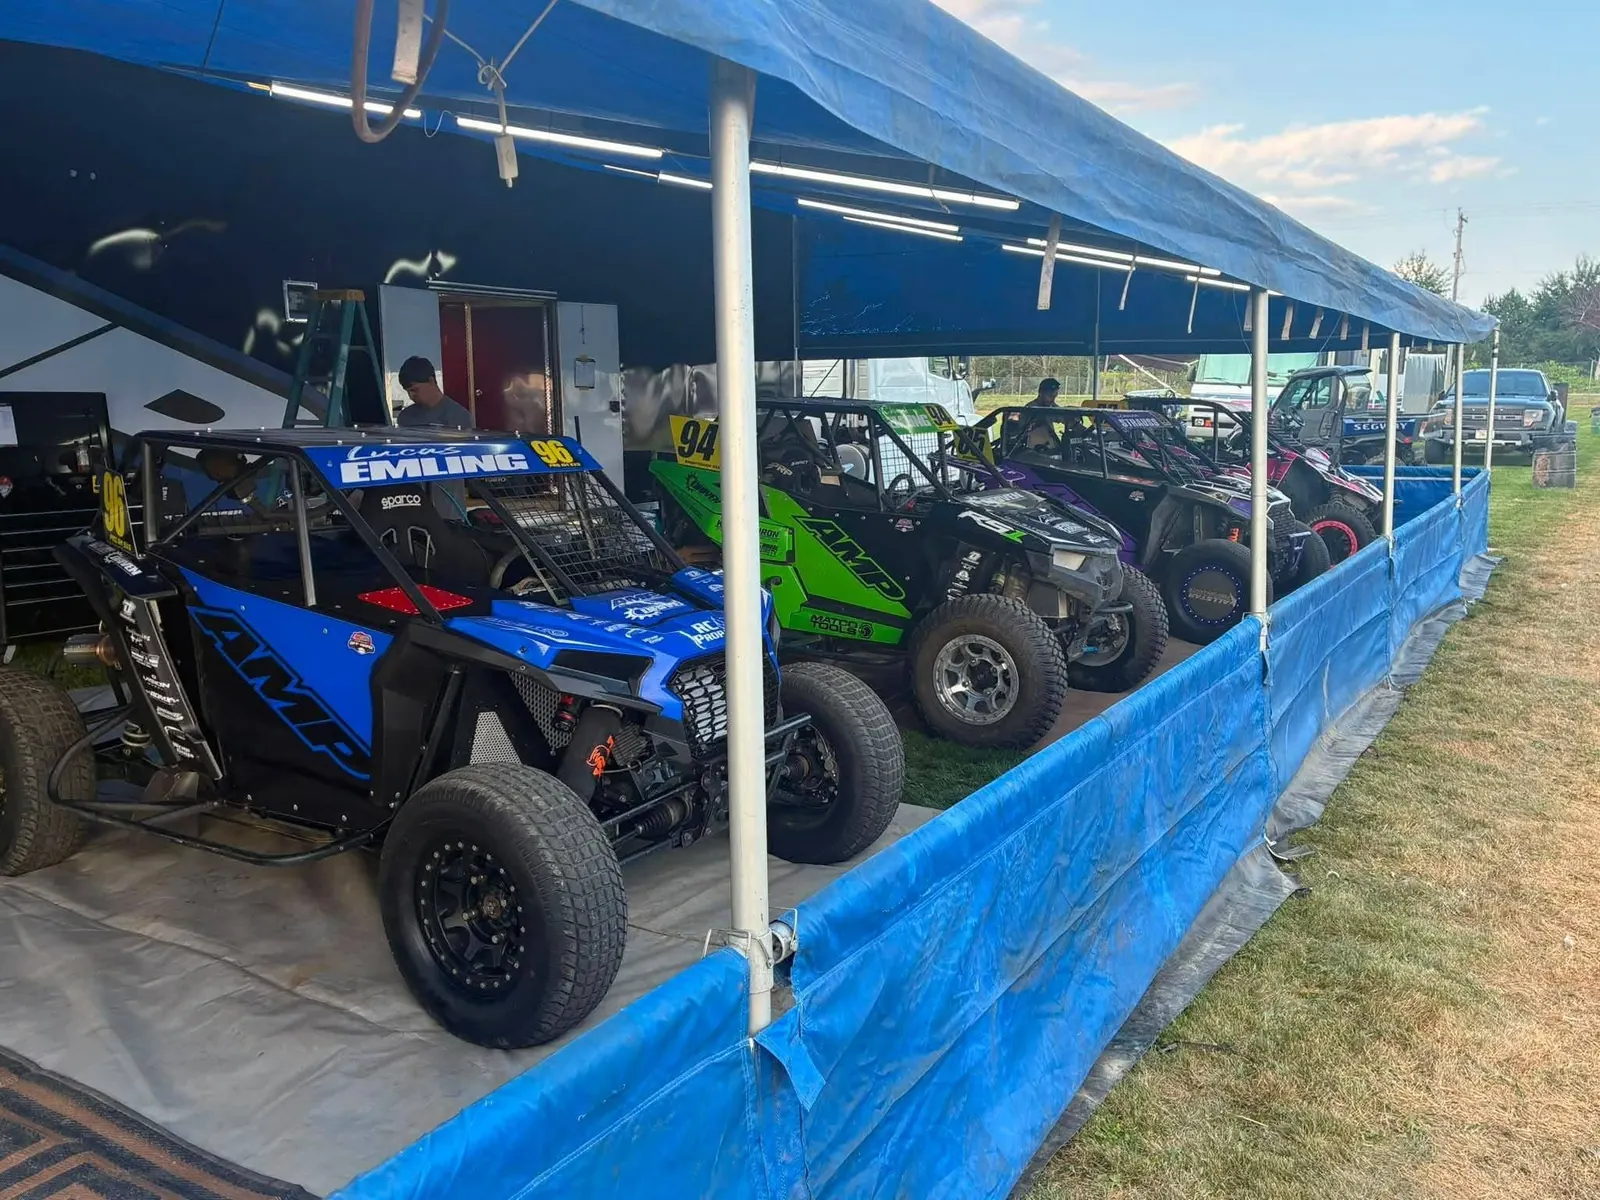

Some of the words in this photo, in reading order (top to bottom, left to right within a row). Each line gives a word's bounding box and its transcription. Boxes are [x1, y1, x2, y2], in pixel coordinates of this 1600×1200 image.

[1118, 418, 1160, 427] STRAUSS
[677, 420, 719, 461] 94
[346, 445, 463, 462] Lucas
[530, 440, 574, 464] 96
[340, 453, 529, 484] EMLING
[103, 471, 125, 537] 96
[381, 493, 421, 508] sparco
[792, 516, 906, 601] AMP
[811, 614, 857, 628] MATCO
[811, 621, 857, 635] TOOLS
[692, 630, 725, 645] PROP
[187, 607, 371, 779] AMP
